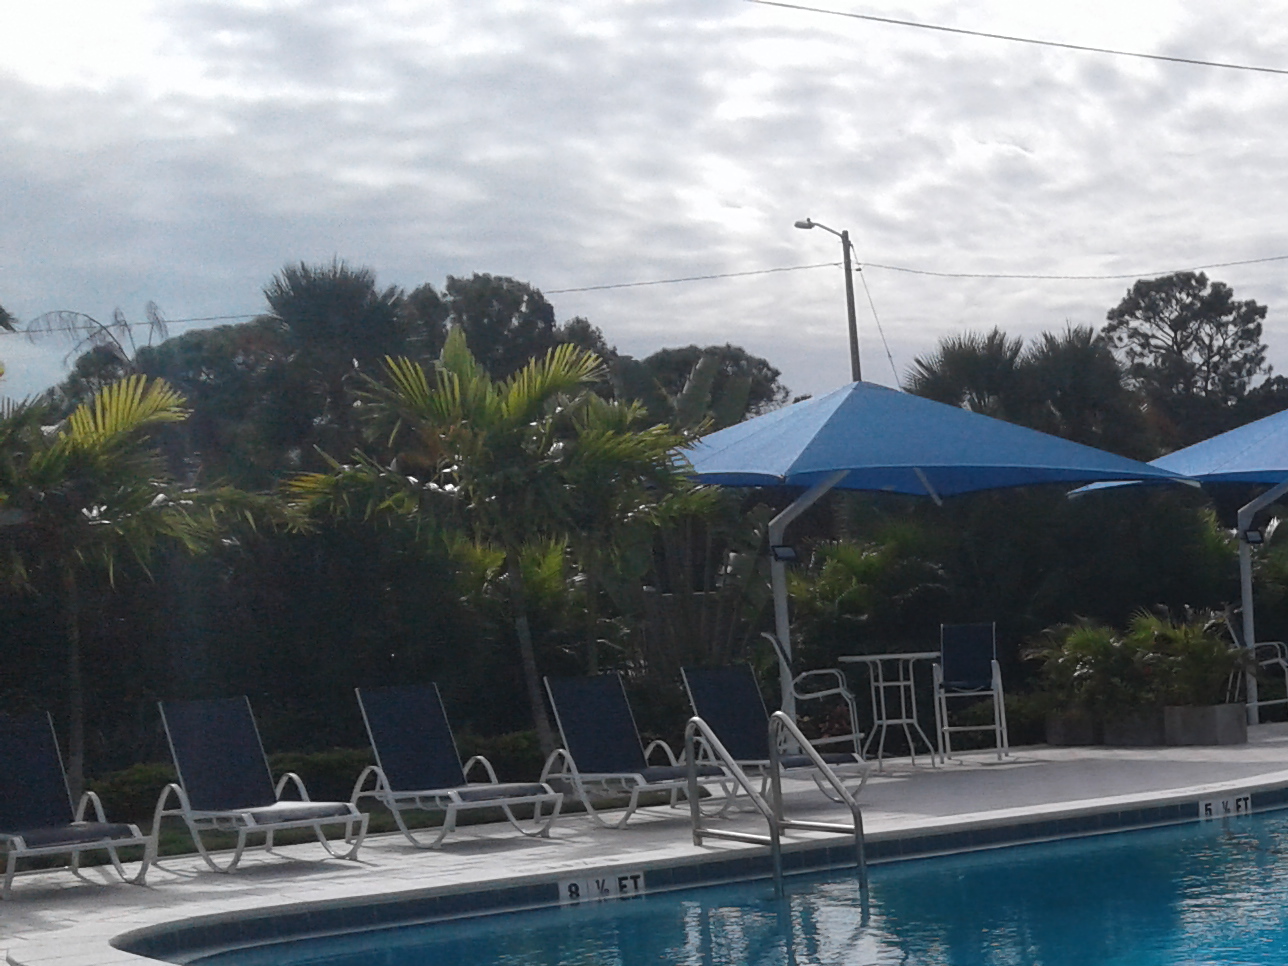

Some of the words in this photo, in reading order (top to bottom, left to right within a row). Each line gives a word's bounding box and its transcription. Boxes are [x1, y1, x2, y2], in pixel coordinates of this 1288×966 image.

[1204, 802, 1212, 817] 5
[1235, 797, 1250, 812] FT
[567, 882, 580, 899] 8
[617, 874, 641, 892] FT
